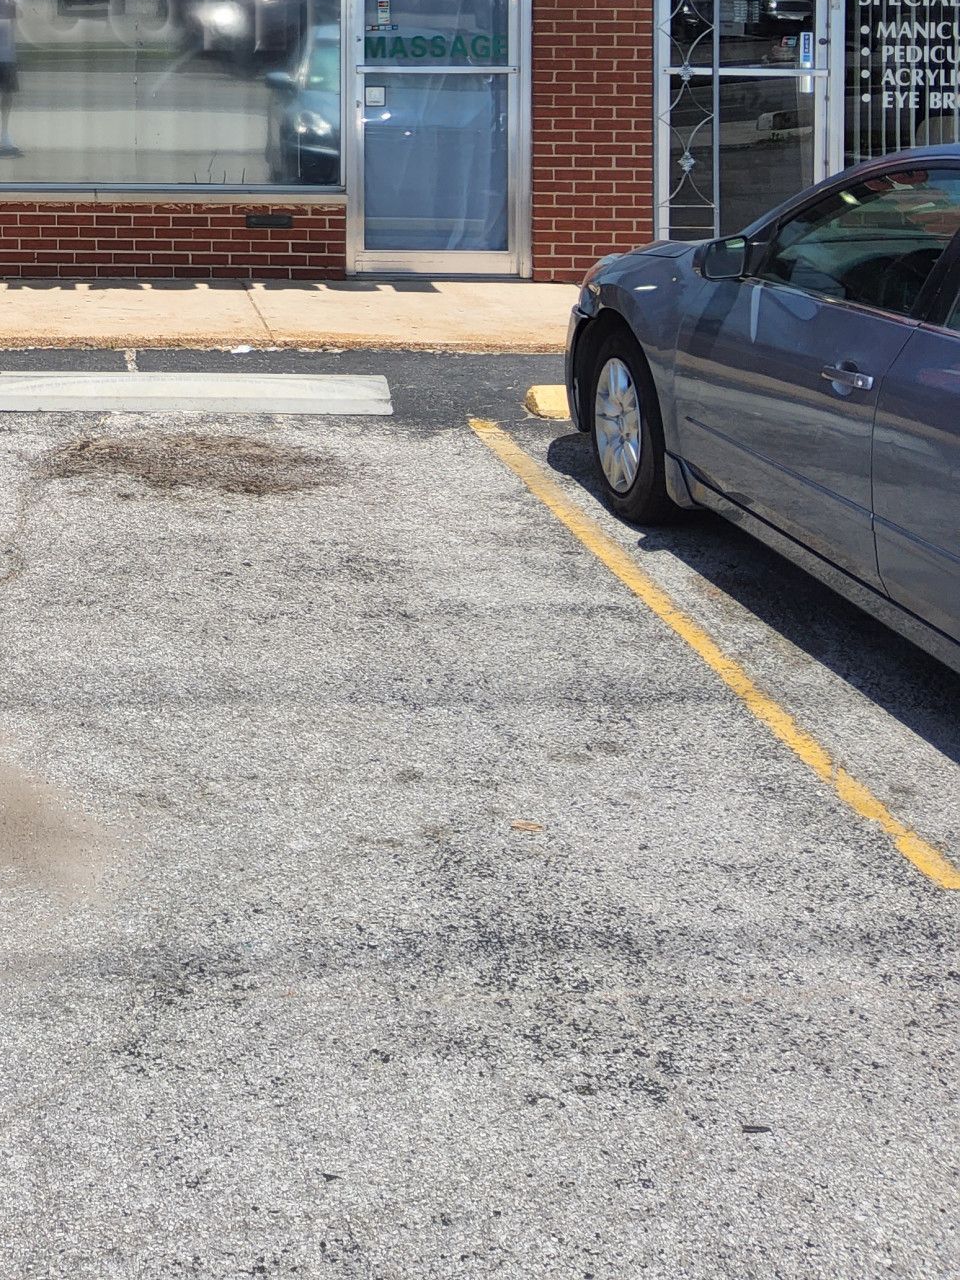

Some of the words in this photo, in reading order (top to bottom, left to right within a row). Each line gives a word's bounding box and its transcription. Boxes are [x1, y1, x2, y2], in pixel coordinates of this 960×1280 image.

[364, 34, 509, 60] MASSAGE
[881, 68, 960, 87] ACRYLI
[882, 91, 920, 109] EYE
